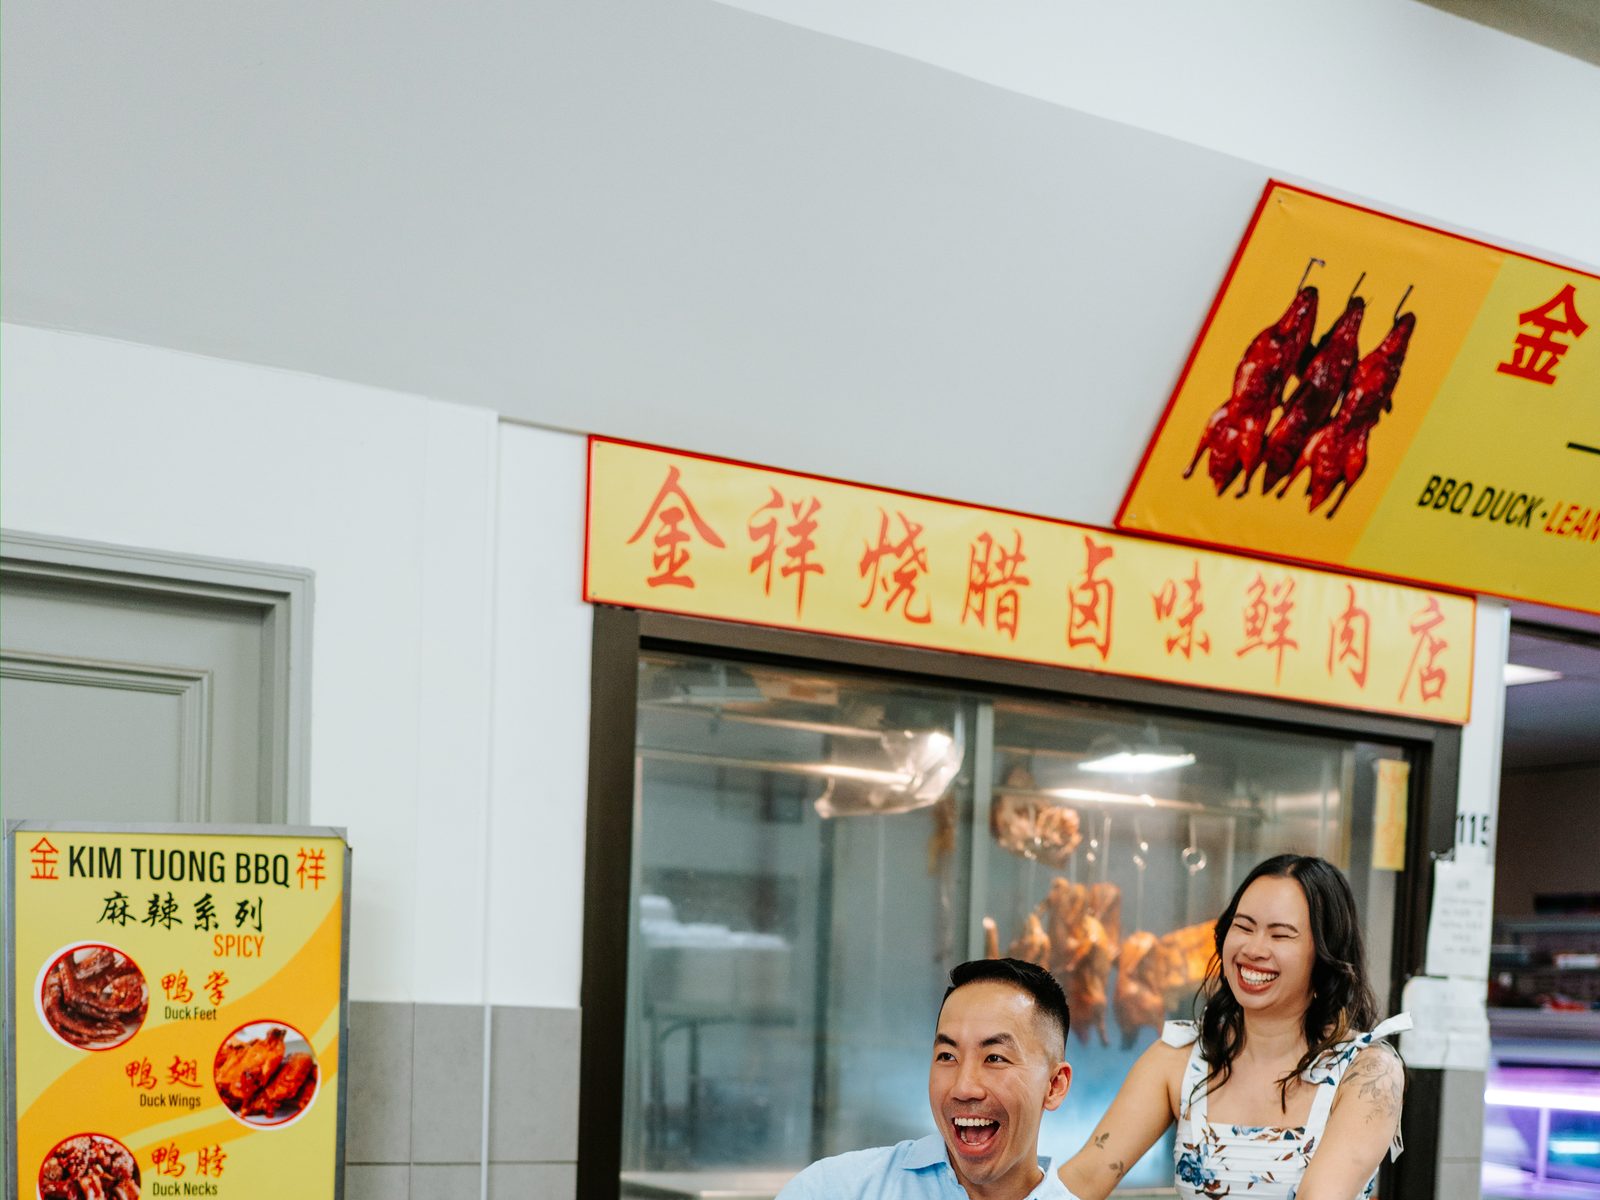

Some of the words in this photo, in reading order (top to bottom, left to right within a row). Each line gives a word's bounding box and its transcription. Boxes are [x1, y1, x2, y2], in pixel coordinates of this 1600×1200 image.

[1495, 283, 1589, 386] 金
[1417, 474, 1474, 514] BBQ
[30, 837, 60, 880] 金
[68, 845, 122, 880] KIM
[130, 847, 226, 884] TUONG
[235, 852, 291, 889] BBQ
[296, 847, 326, 891] 祥
[96, 890, 264, 933] 麻辣系列
[213, 933, 265, 958] SPICY
[164, 1005, 192, 1020] Duck
[193, 1006, 217, 1021] Feet
[139, 1093, 167, 1108] Duck
[168, 1094, 202, 1110] Wings
[152, 1181, 181, 1196] Duck
[183, 1182, 218, 1197] Necks
